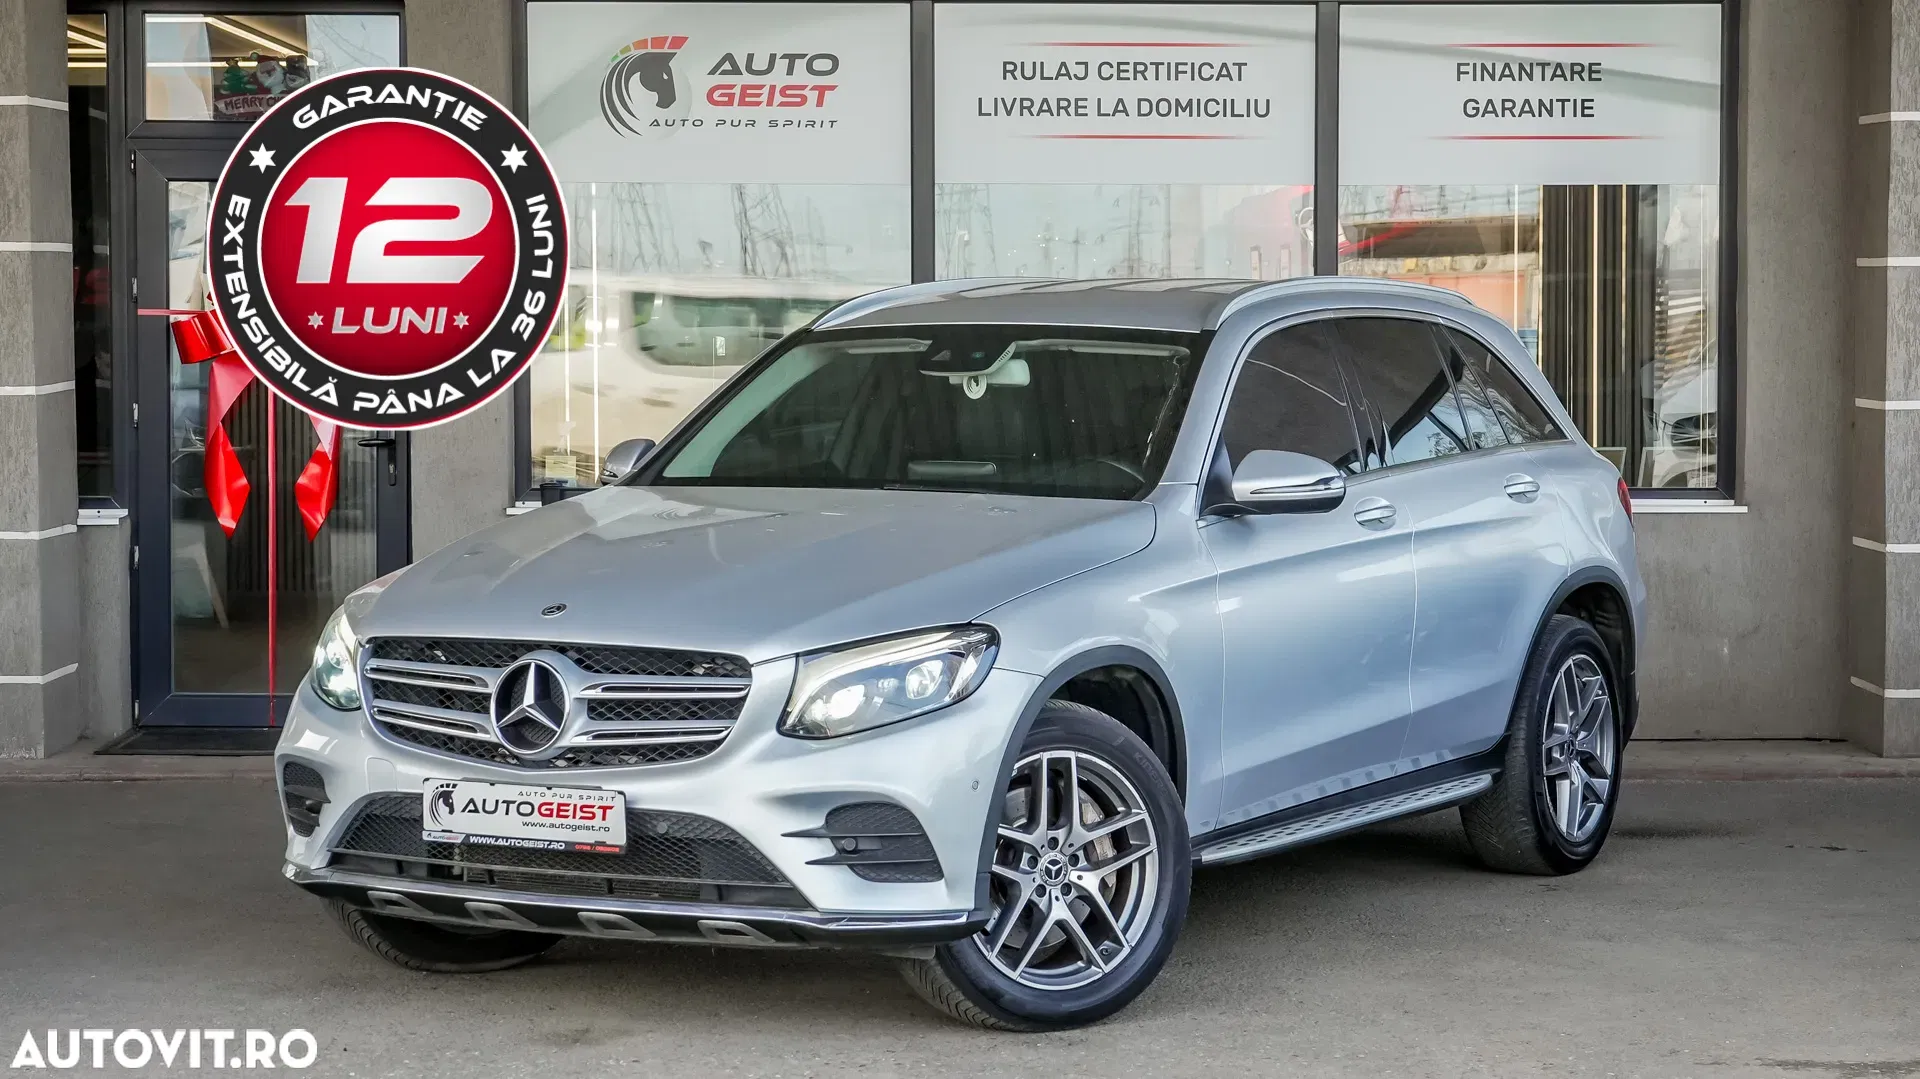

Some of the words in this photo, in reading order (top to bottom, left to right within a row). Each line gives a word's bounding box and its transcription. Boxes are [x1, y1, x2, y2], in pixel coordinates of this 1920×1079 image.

[707, 53, 840, 77] AUTO
[1003, 61, 1089, 81] RULAJ
[1098, 62, 1248, 82] CERTIFICAT
[1456, 62, 1603, 82] FINANTARE
[223, 97, 264, 111] MERRY
[706, 84, 839, 108] GEIST
[978, 97, 1088, 117] LIVRARE
[1097, 98, 1130, 117] LA
[1137, 98, 1271, 118] DOMICILIU
[1463, 98, 1595, 118] GARANTIE
[649, 118, 704, 128] AUTO
[715, 119, 757, 128] PUR
[768, 119, 838, 129] SPIRIT
[460, 797, 615, 821] AUTOGEIST
[521, 821, 610, 832] www.autogeist.ro
[469, 835, 566, 849] WWW.AUTOGEIST.RO
